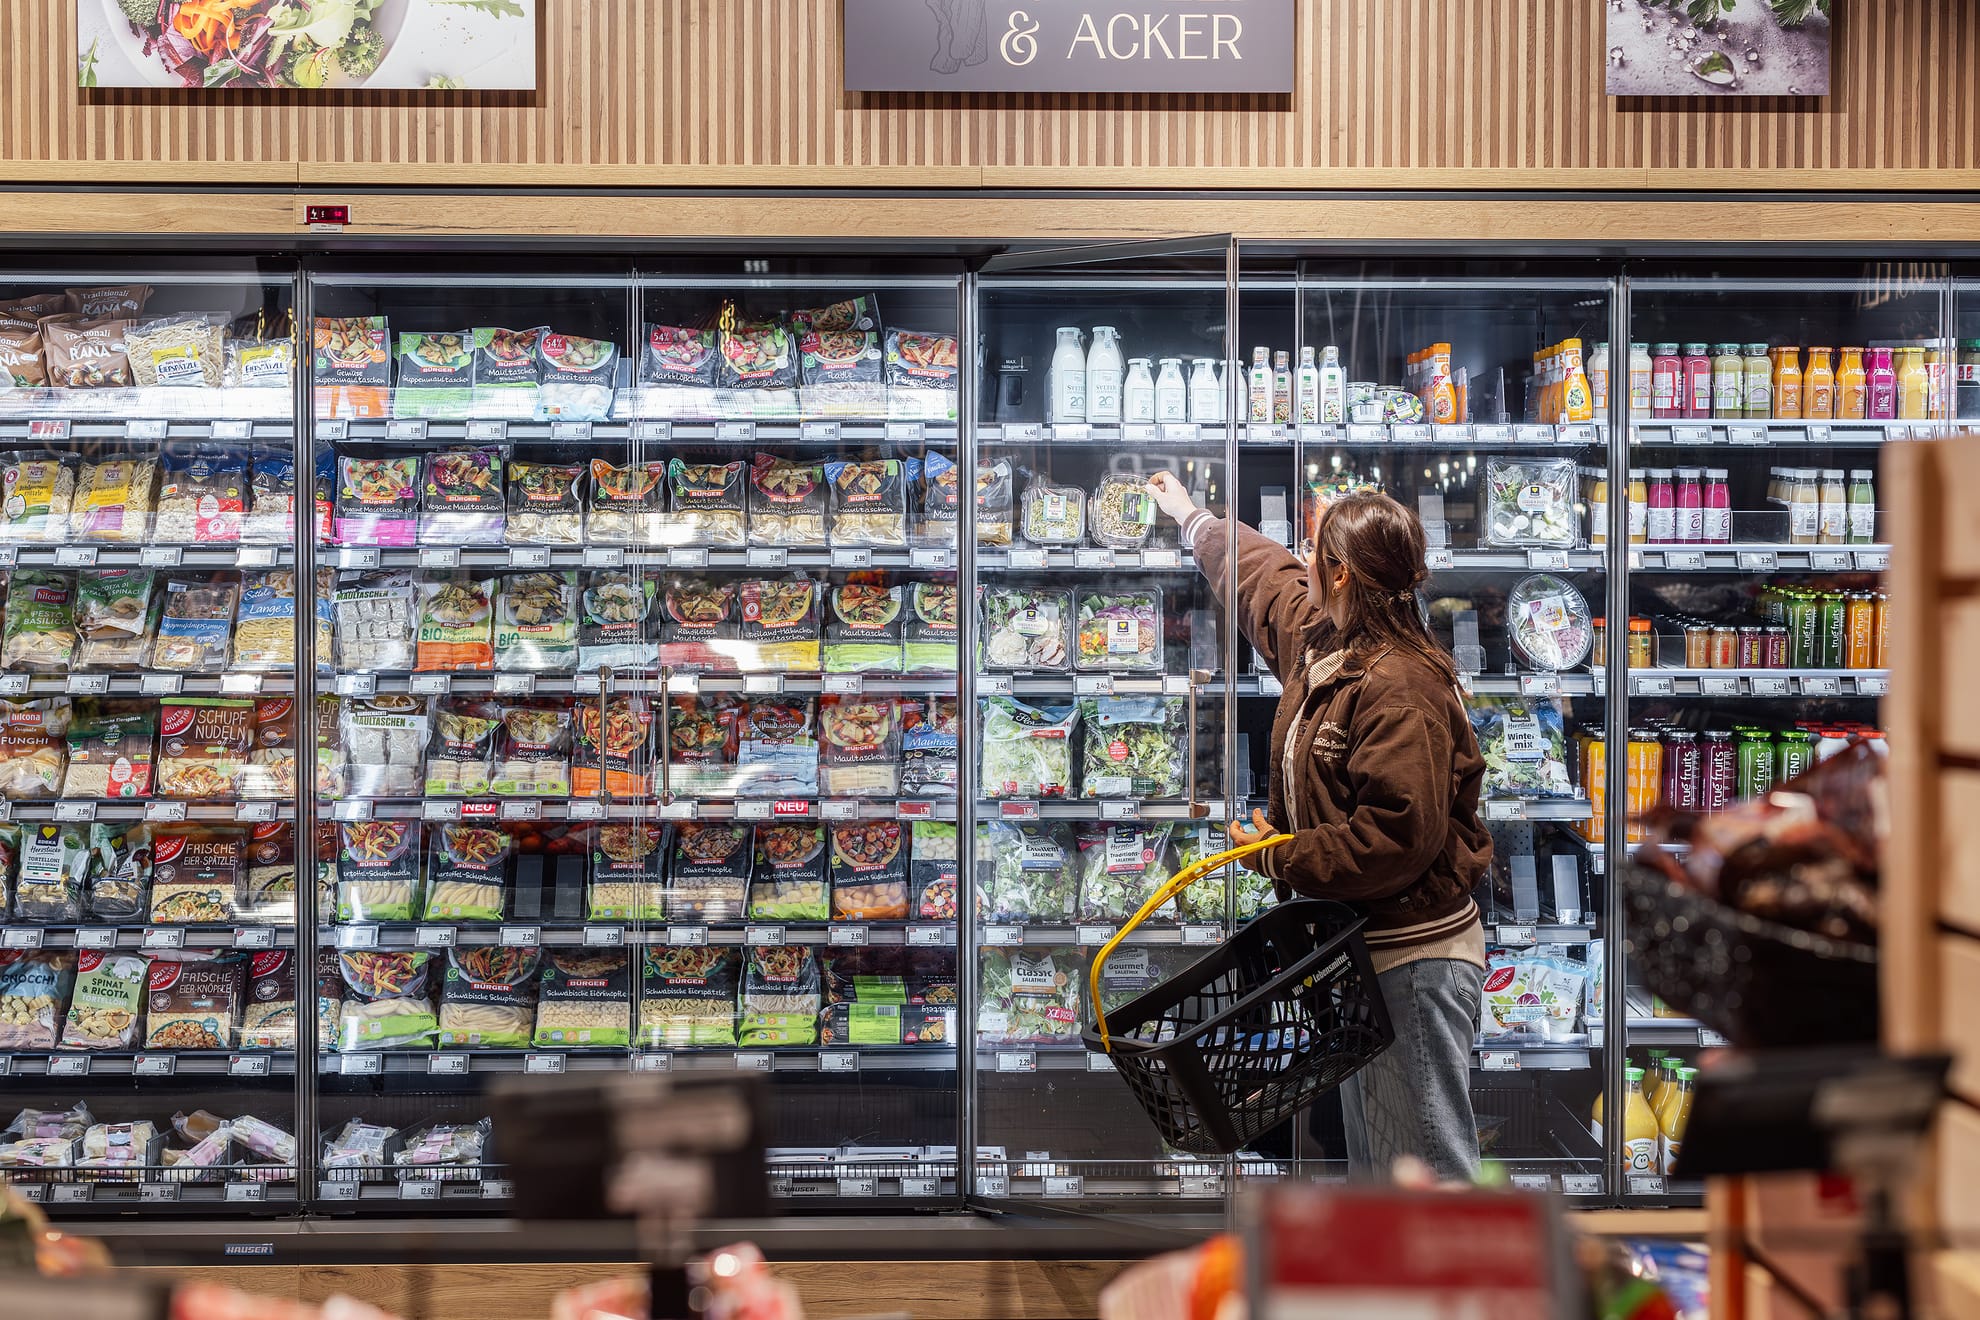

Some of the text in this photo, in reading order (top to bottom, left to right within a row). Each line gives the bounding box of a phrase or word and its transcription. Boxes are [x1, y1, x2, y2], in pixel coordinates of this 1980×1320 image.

[1000, 11, 1244, 66] & ACKER
[81, 303, 120, 315] RANA
[653, 332, 670, 342] 54%
[546, 339, 564, 349] 54%
[70, 345, 111, 359] RANA
[337, 370, 363, 378] Gemüse
[489, 368, 537, 376] Maultaschen
[912, 369, 945, 377] BÜRGER
[315, 377, 385, 385] Suppenmaultaschen
[545, 373, 604, 382] Hochzeitssuppe
[824, 427, 834, 435] 1.99
[428, 503, 450, 511] Vegane
[854, 555, 865, 563] 3.99
[37, 592, 65, 601] hilcona
[337, 590, 389, 599] MAULTASCHEN
[250, 604, 281, 615] Lange
[422, 628, 441, 641] BIO
[840, 630, 892, 638] Maultaschen
[500, 633, 519, 646] BIO
[10, 680, 21, 688] 3.79
[90, 680, 100, 688] 3.79
[12, 714, 41, 722] hilcona
[164, 710, 190, 731] GÜNSTIG
[198, 710, 246, 724] SCHUPF
[353, 717, 406, 727] MAULTASCHEN
[195, 726, 245, 739] NUDELN
[834, 754, 886, 762] Maultaschen
[1754, 752, 1765, 781] fruits
[1681, 751, 1692, 806] true fruits
[1712, 751, 1723, 807] true fruits
[465, 804, 491, 812] NEU
[777, 803, 804, 812] NEU
[30, 846, 61, 854] Herzstücke
[186, 844, 235, 854] FRISCHE
[184, 856, 235, 866] EIER-SPÄTZLE
[683, 866, 732, 874] Dinkel-Knöpfle
[761, 870, 817, 879] Kartoffel-Gnocchi
[836, 876, 856, 884] Gnocchi
[523, 934, 534, 942] 2.29
[606, 934, 618, 942] 2.29
[768, 932, 779, 940] 2.59
[851, 932, 862, 940] 2.59
[929, 932, 939, 940] 2.59
[1205, 932, 1216, 940] 1.99
[182, 972, 231, 982] FRISCHE
[1017, 968, 1052, 977] Classic
[1292, 952, 1349, 996] Wir Lebensmittel.
[1, 974, 55, 985] GNOCCHI
[92, 979, 123, 989] SPINAT
[82, 985, 128, 999] & RICOTTA
[179, 984, 230, 994] EIER-KNÖPFLE
[645, 987, 726, 997] Schwäbische Eierspätzle
[447, 992, 487, 1000] Schwäbische
[590, 990, 627, 998] Eierknöpfle
[82, 995, 128, 1006] TORTELLONI
[1046, 1009, 1060, 1018] XL
[365, 1060, 376, 1068] 3.99
[452, 1060, 463, 1068] 3.99
[548, 1060, 559, 1068] 3.99
[1019, 1059, 1030, 1067] 2.29
[860, 1184, 872, 1192] 7.29
